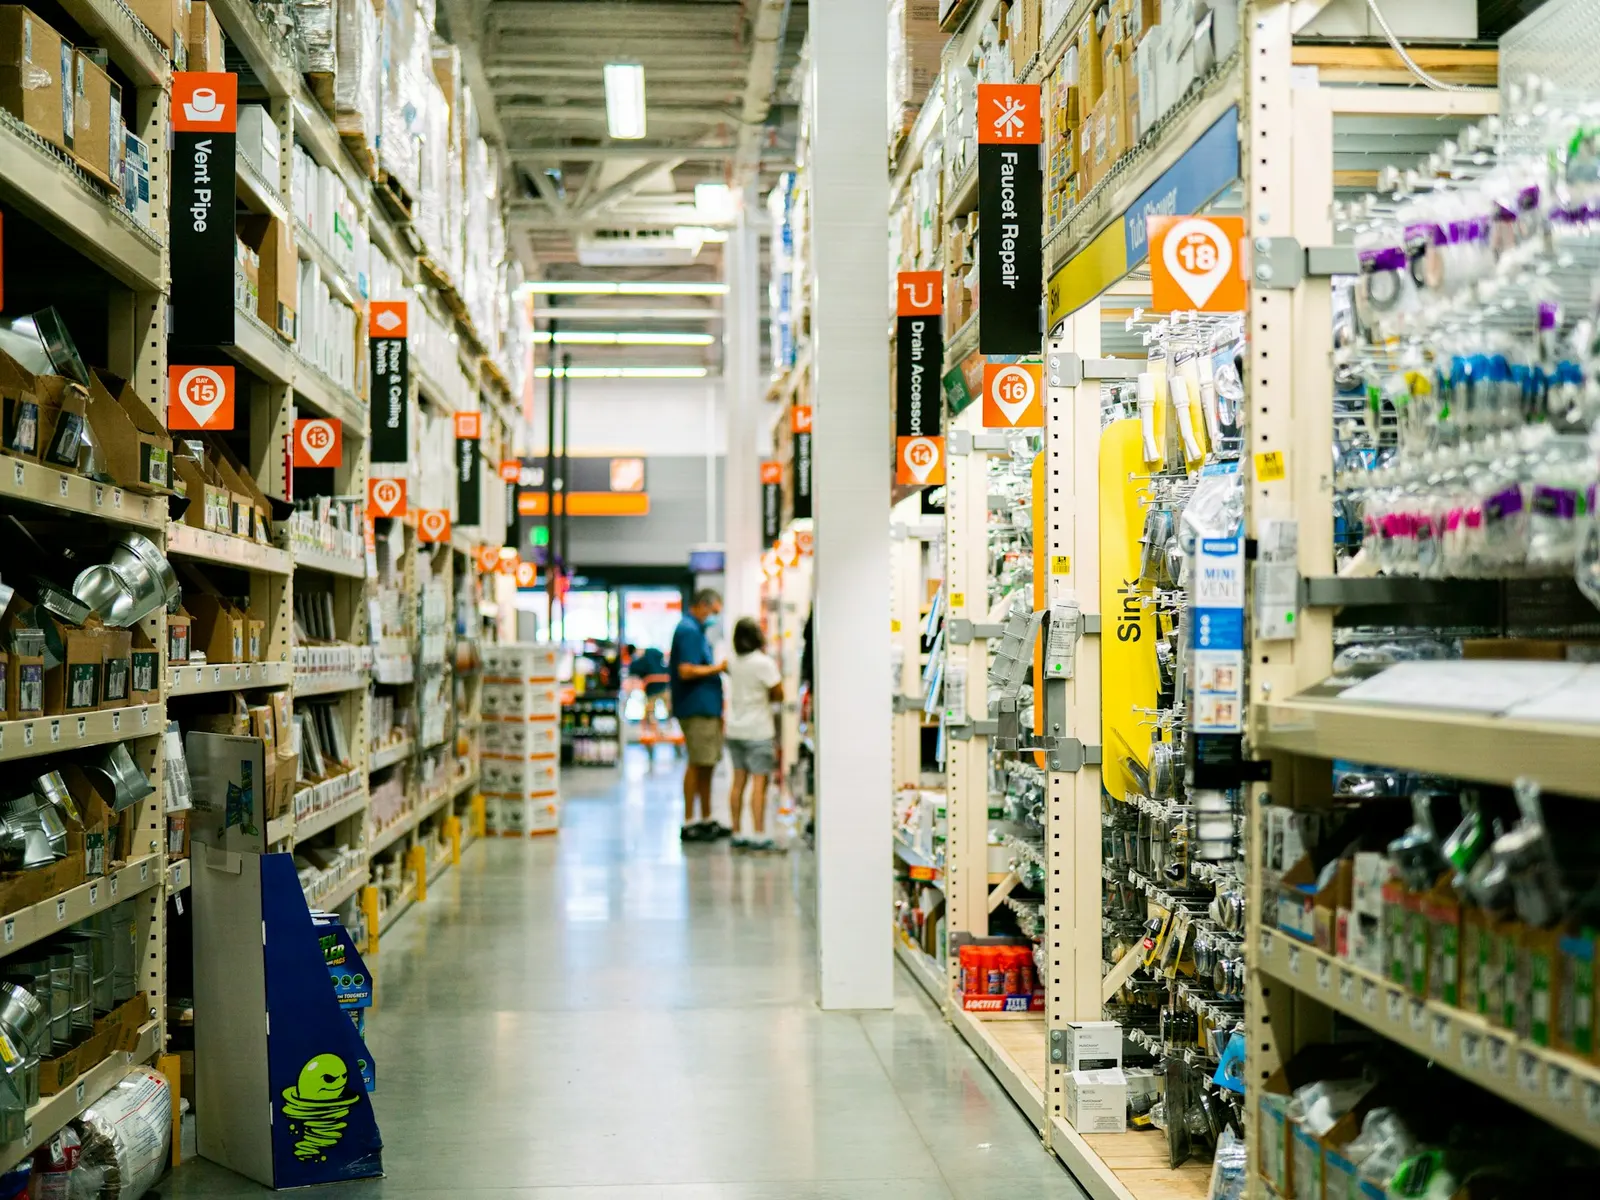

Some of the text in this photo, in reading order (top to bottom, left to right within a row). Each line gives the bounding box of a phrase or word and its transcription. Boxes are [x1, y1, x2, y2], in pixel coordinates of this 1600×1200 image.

[189, 139, 213, 232] Vent Pipe
[998, 152, 1020, 290] Faucet Repair
[1179, 244, 1217, 270] 18
[376, 340, 388, 375] Vents
[387, 340, 402, 428] Floor & Ceiling
[910, 321, 925, 437] Drain Accessori
[190, 384, 215, 402] 15
[1002, 382, 1025, 400] 16
[309, 432, 328, 446] 13
[913, 450, 931, 463] 14
[380, 489, 393, 501] 11
[1204, 568, 1236, 580] MINI
[1200, 581, 1240, 598] VENT
[1117, 578, 1142, 643] Sink
[965, 999, 1003, 1009] LOCTITE
